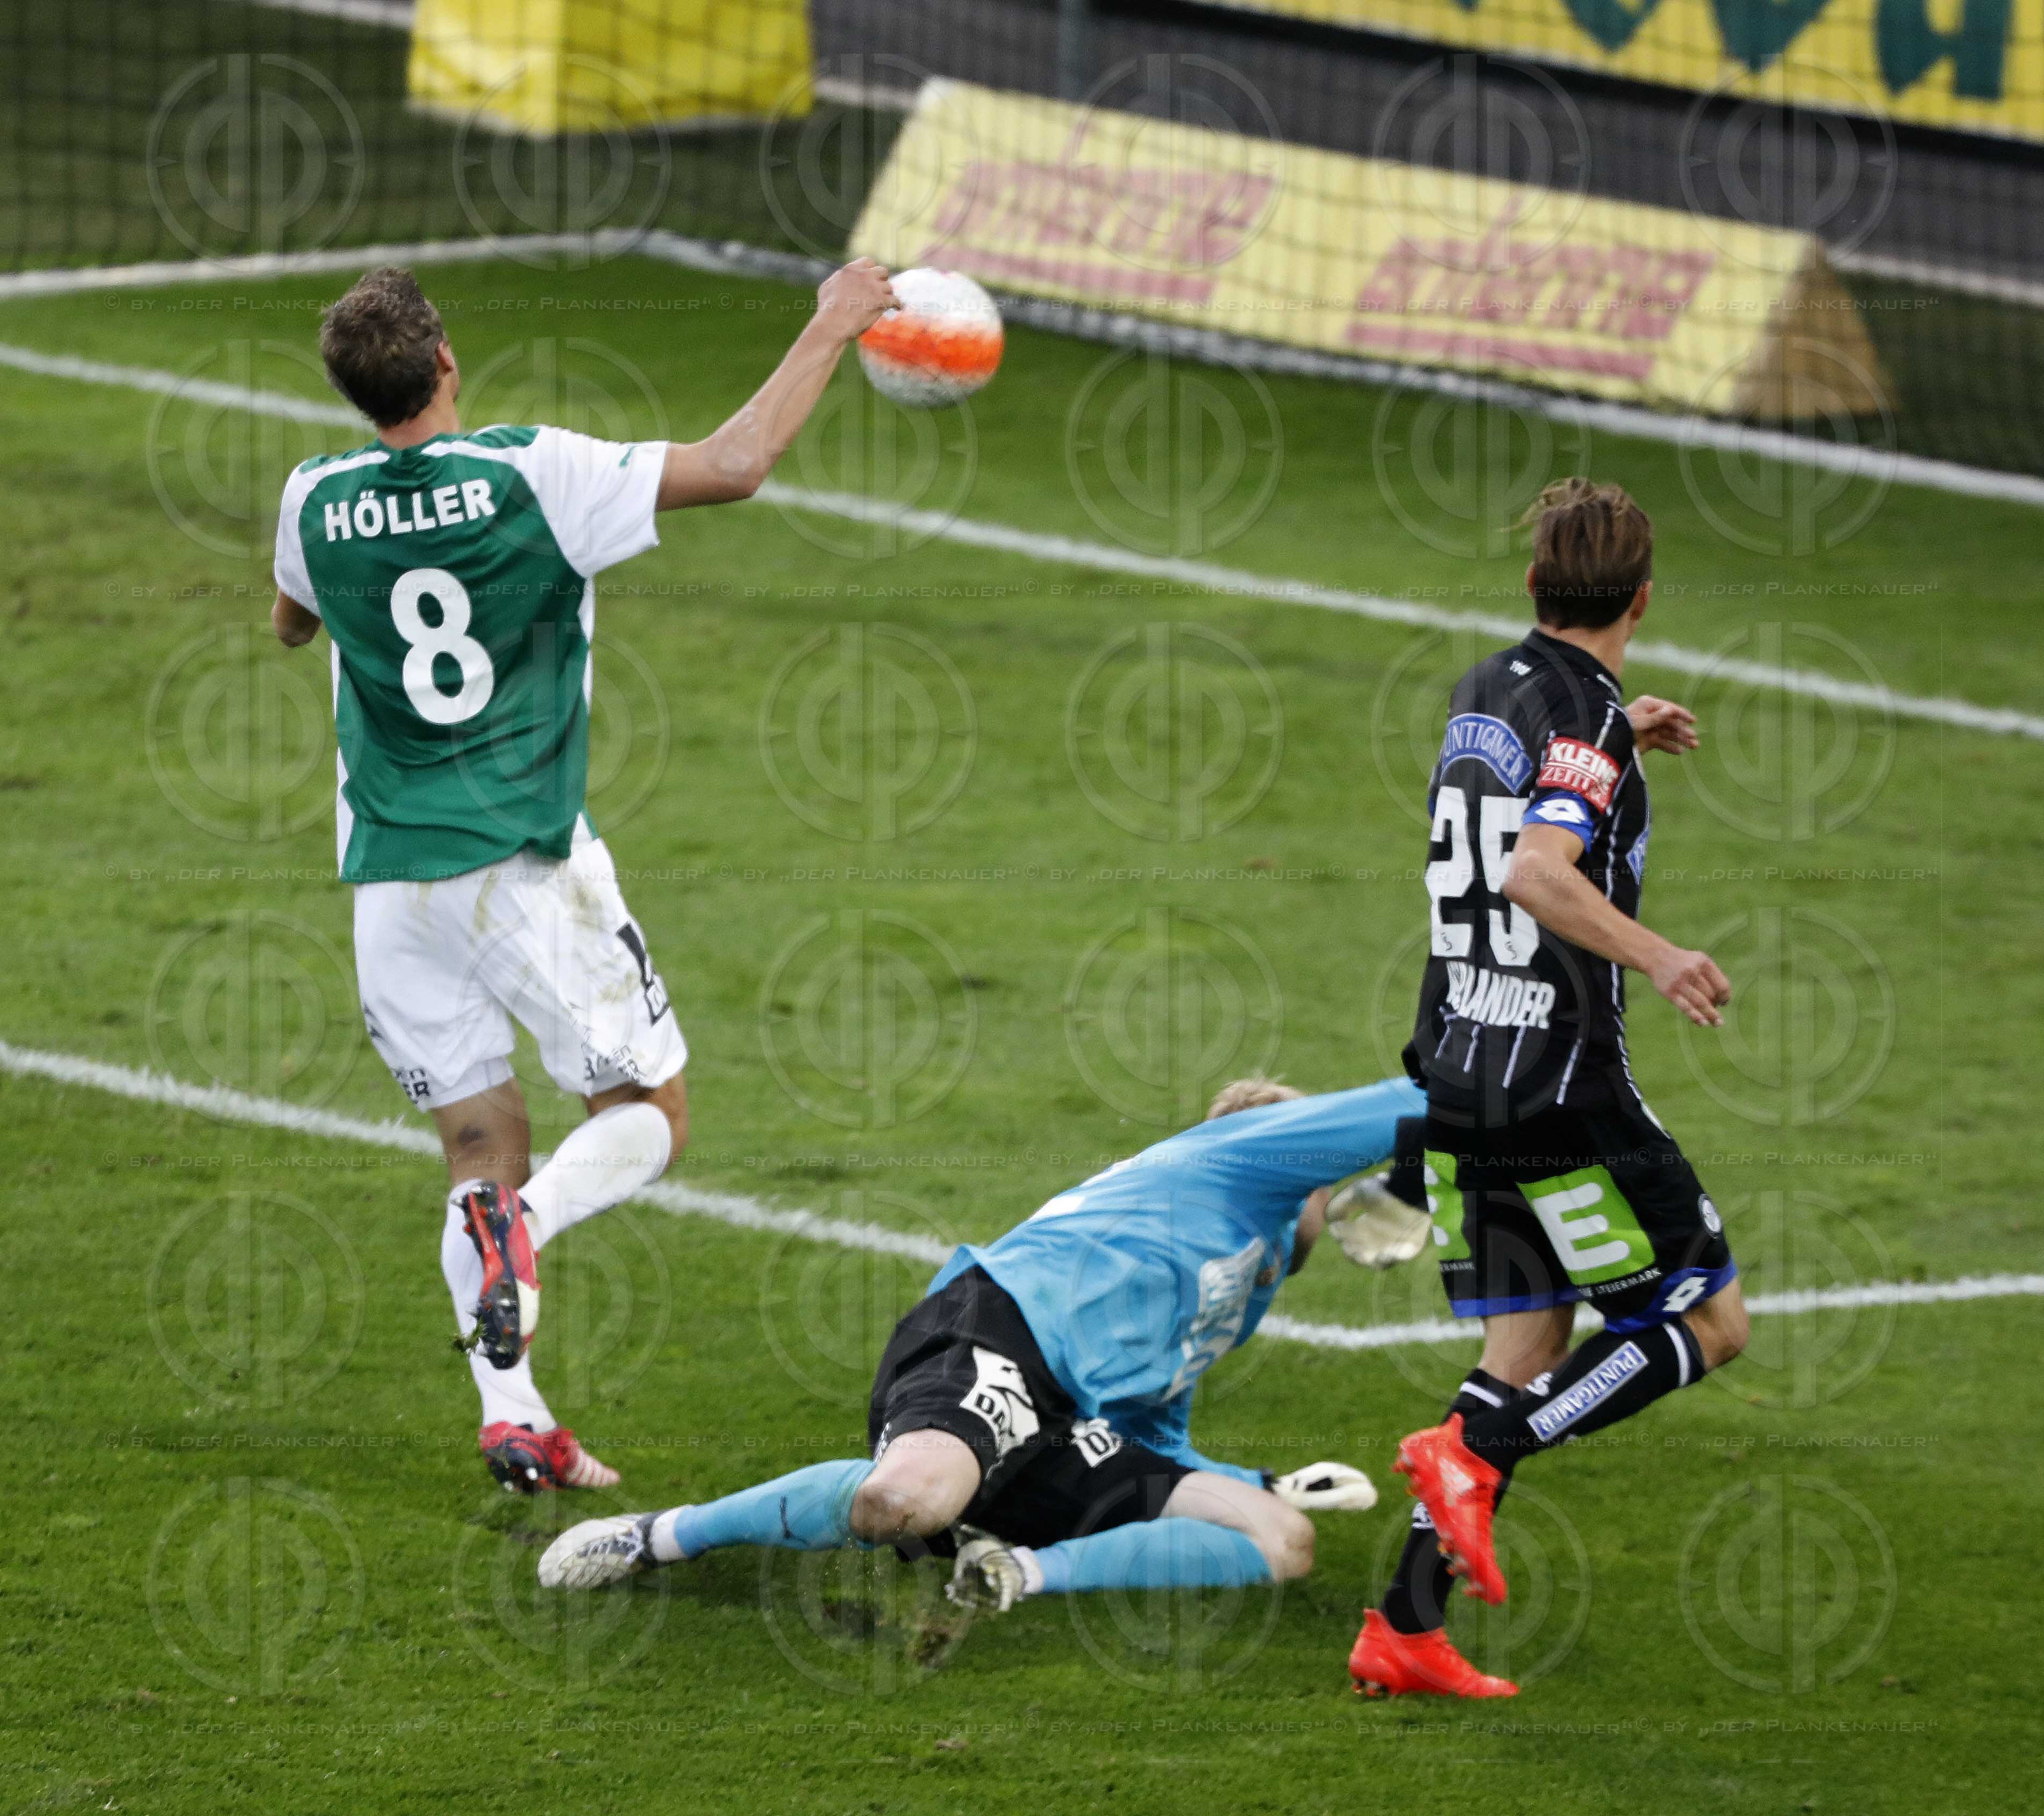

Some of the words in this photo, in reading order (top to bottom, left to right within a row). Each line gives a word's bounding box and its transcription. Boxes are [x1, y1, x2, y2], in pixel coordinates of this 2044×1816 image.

[324, 478, 497, 542] HÖLLER
[391, 567, 495, 726] 8
[1424, 786, 1541, 967] 25
[1533, 1182, 1630, 1272] E
[1537, 1351, 1638, 1432] PUNTIGAMER
